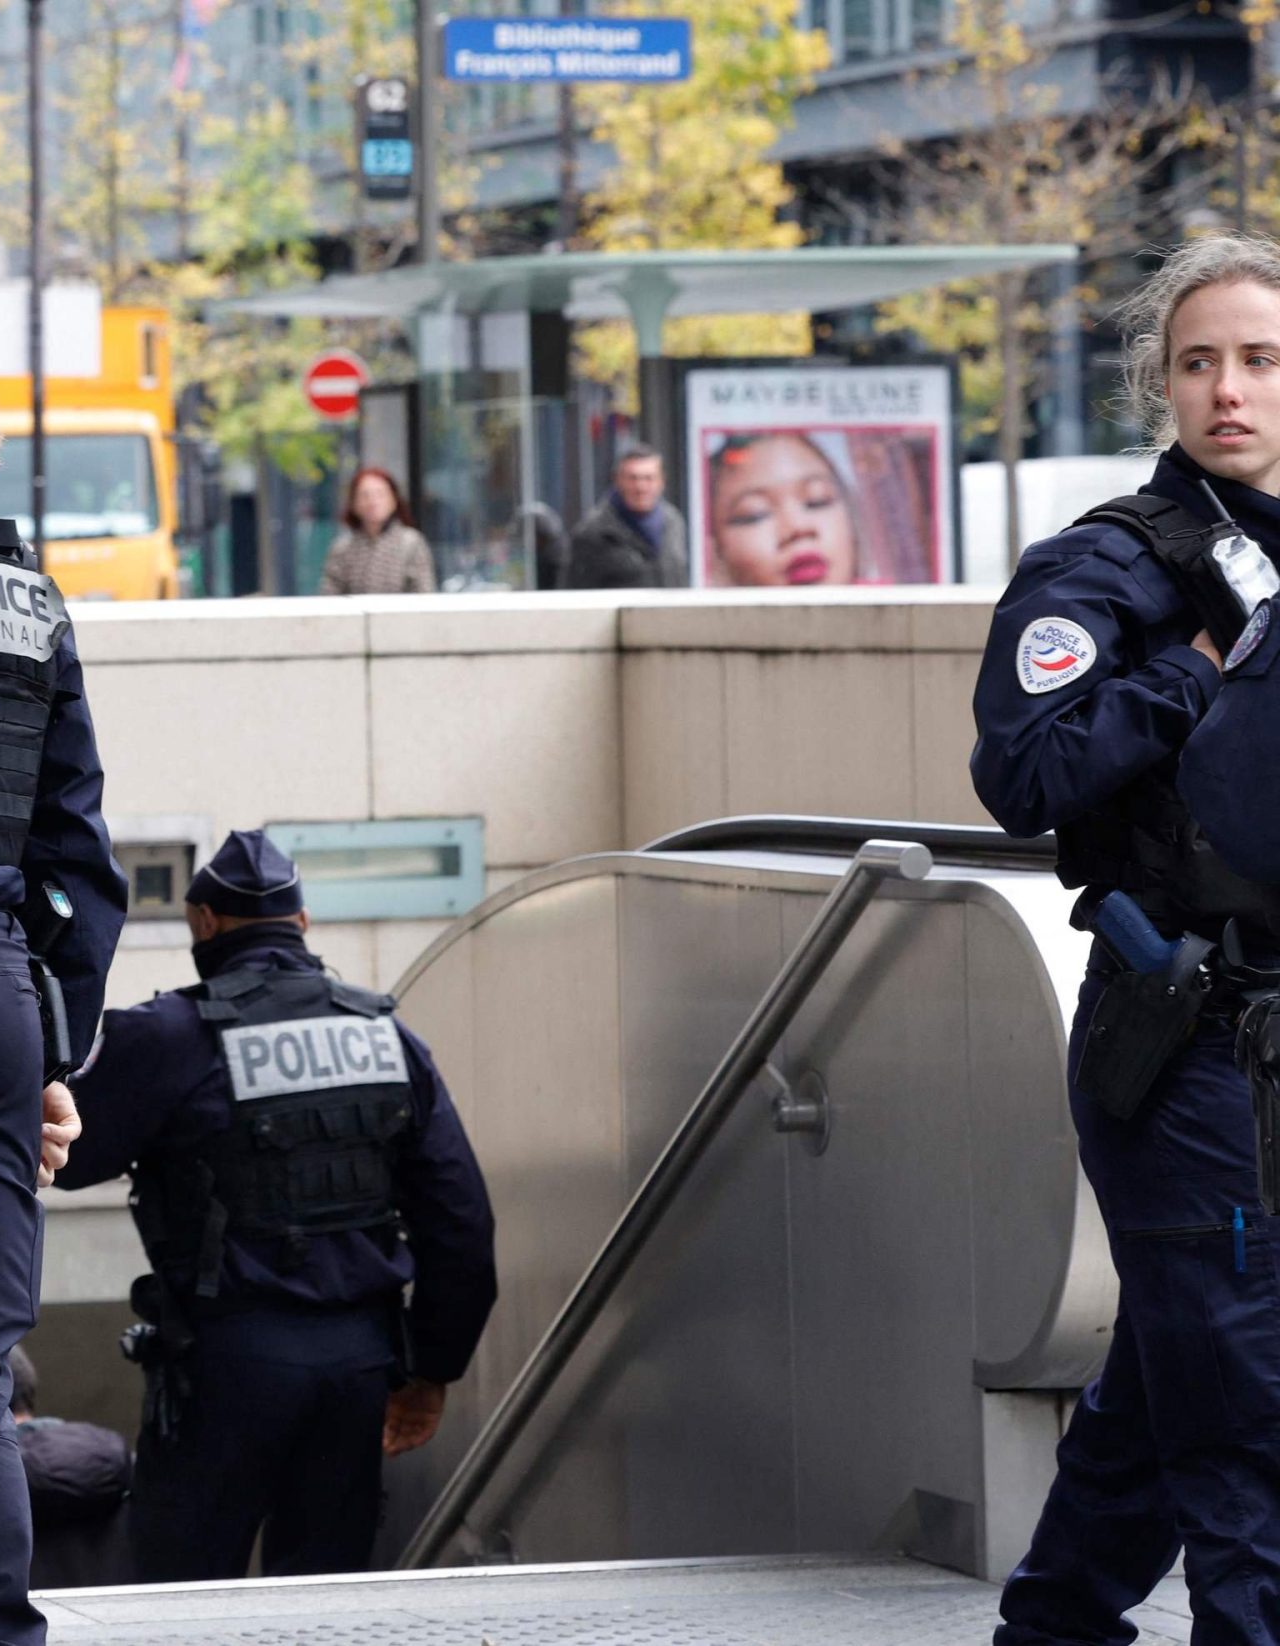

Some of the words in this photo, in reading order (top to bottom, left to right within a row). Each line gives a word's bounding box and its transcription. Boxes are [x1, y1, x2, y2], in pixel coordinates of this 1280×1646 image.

[494, 23, 641, 51] Bibliothèque
[455, 49, 552, 79] François
[555, 49, 680, 76] Mitterrand
[711, 379, 922, 404] MAYBELLINE
[1031, 630, 1088, 660] NATIONALE
[1045, 626, 1080, 646] POLICE
[1036, 665, 1080, 689] PUBLIQUE
[238, 1025, 397, 1088] POLICE
